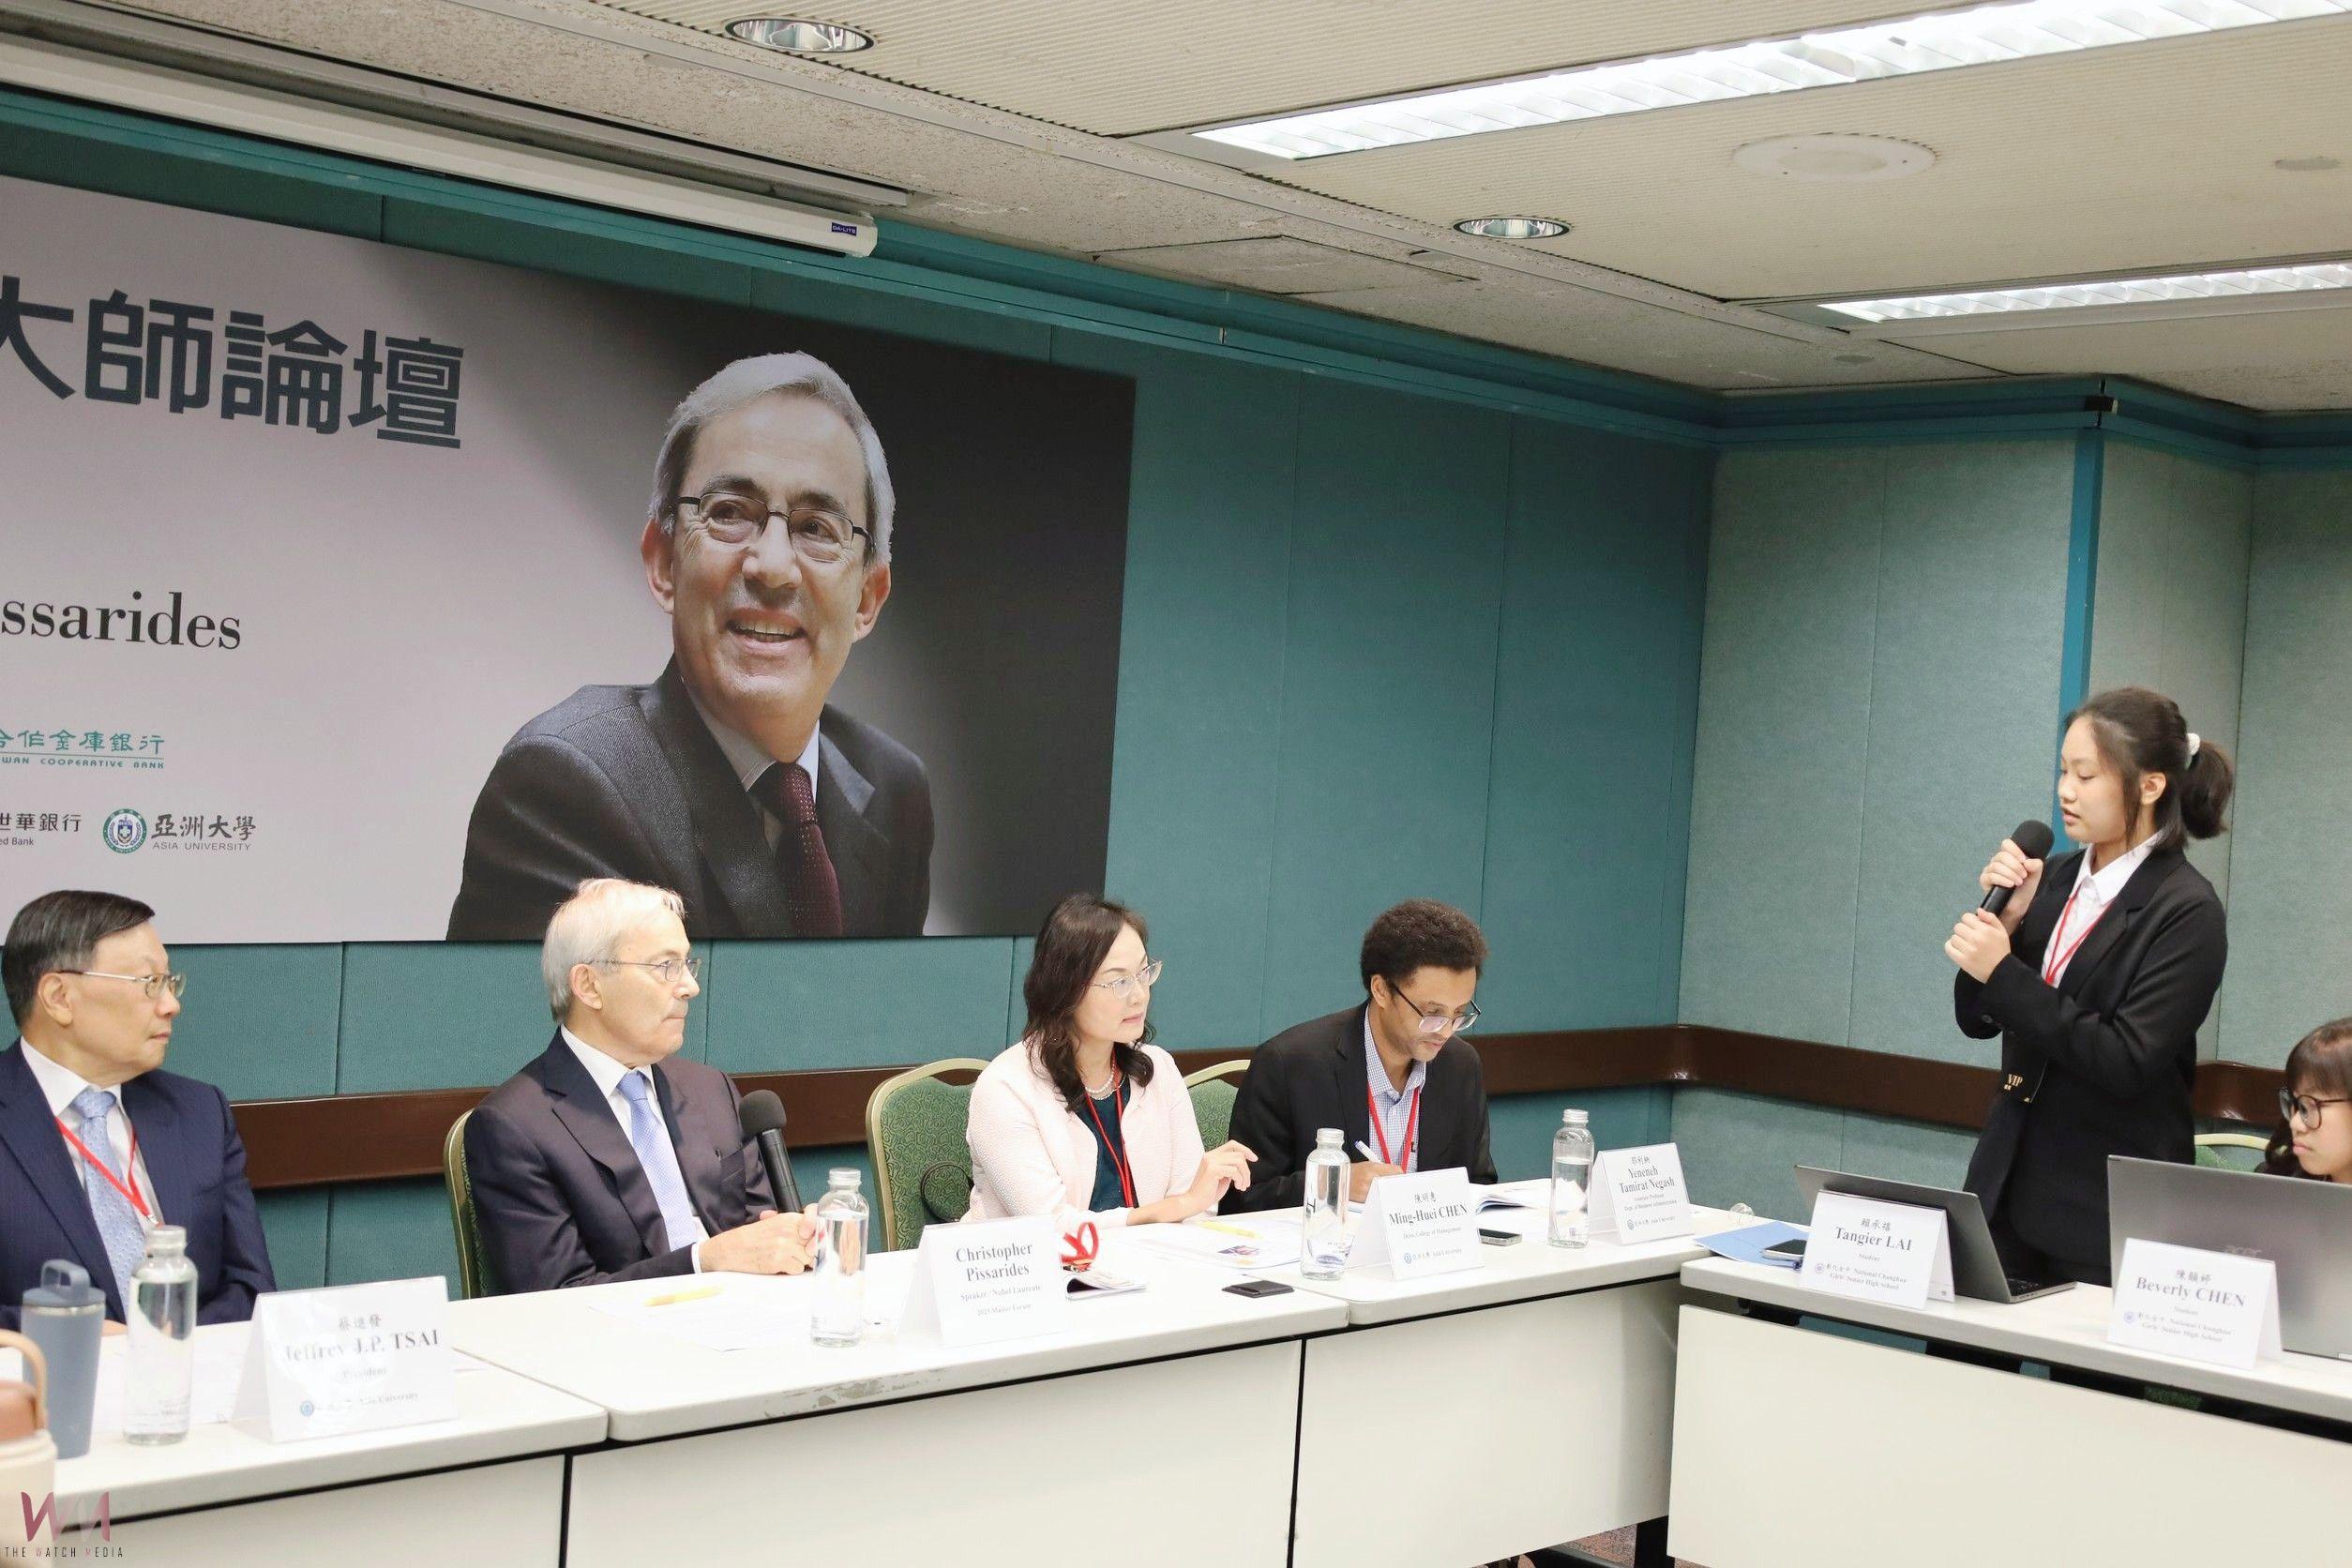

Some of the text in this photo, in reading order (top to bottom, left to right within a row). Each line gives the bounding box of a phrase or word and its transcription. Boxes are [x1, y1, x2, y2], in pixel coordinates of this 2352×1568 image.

[0, 275, 464, 449] 大師論壇
[1, 591, 241, 650] ssarides
[40, 758, 124, 768] COOPERATIVE
[151, 813, 256, 841] 亞洲大學
[12, 837, 35, 845] Bank
[184, 842, 251, 851] UNIVERSITY
[1389, 1203, 1468, 1226] Ming-Huei CHEN
[1835, 1227, 1912, 1251] Tangier LAI
[956, 1243, 1033, 1262] Christopher
[967, 1263, 1030, 1282] Pissarides
[2136, 1277, 2247, 1306] Beverly CHEN
[285, 1329, 440, 1362] Jeffrey J.P. TSAI
